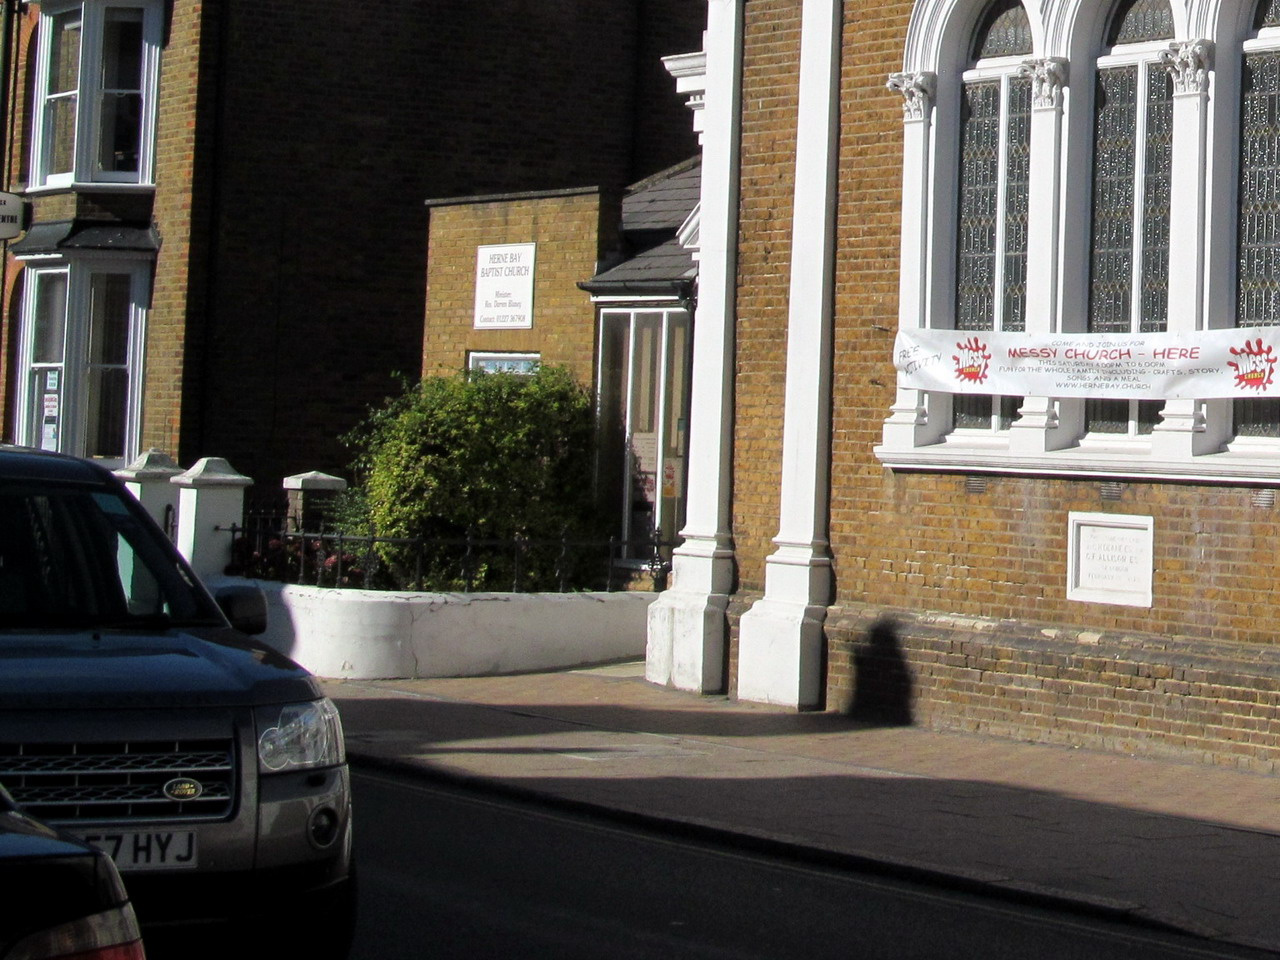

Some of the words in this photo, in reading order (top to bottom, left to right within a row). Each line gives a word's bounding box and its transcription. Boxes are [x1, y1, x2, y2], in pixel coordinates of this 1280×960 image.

[0, 215, 17, 223] NTRE
[489, 253, 509, 264] HERNE
[509, 252, 522, 263] BAY
[480, 267, 503, 278] BAPTIST
[504, 266, 530, 277] CHURCH
[899, 345, 920, 363] FREE
[1008, 347, 1058, 359] MESSY
[1064, 348, 1132, 360] CHURCH
[1153, 347, 1200, 359] HERE
[1058, 360, 1094, 368] SATURDAY
[1044, 366, 1072, 374] WHOLE
[1072, 367, 1100, 375] FAMILY
[133, 832, 194, 863] HYJ
